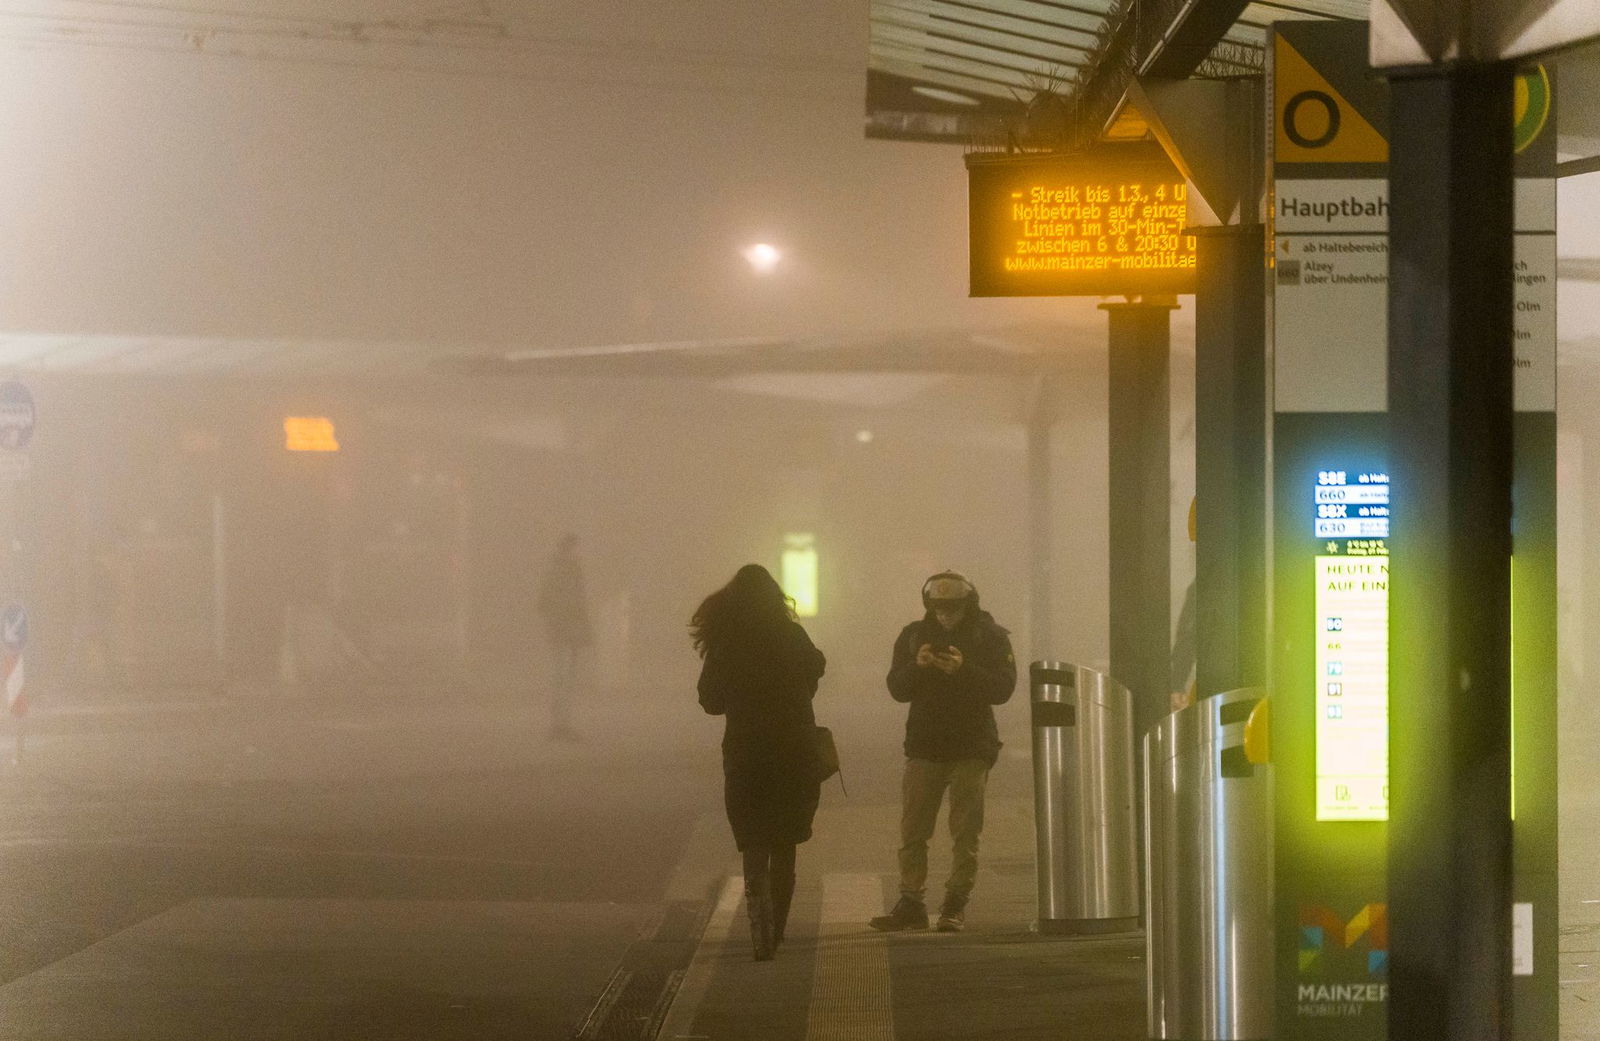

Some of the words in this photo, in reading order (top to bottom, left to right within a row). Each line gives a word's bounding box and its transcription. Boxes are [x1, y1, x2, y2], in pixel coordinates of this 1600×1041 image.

[1031, 187, 1079, 203] Streik
[1086, 186, 1110, 202] bis
[1155, 184, 1166, 201] 4
[1013, 203, 1101, 220] Notbetrieb
[1108, 203, 1136, 219] auf
[1024, 220, 1074, 236] Linien
[1082, 220, 1101, 235] im
[1017, 237, 1090, 253] zwischen
[1098, 236, 1108, 252] 6
[1116, 236, 1128, 252] &
[1135, 235, 1178, 252] 20:30
[1187, 235, 1197, 251] U
[1303, 243, 1316, 253] ab
[1304, 261, 1333, 273] Alzey
[1304, 274, 1327, 284] über
[1320, 489, 1345, 500] 660
[1327, 565, 1374, 575] HEUTE
[1328, 581, 1355, 591] AUF
[1362, 581, 1386, 591] EIN
